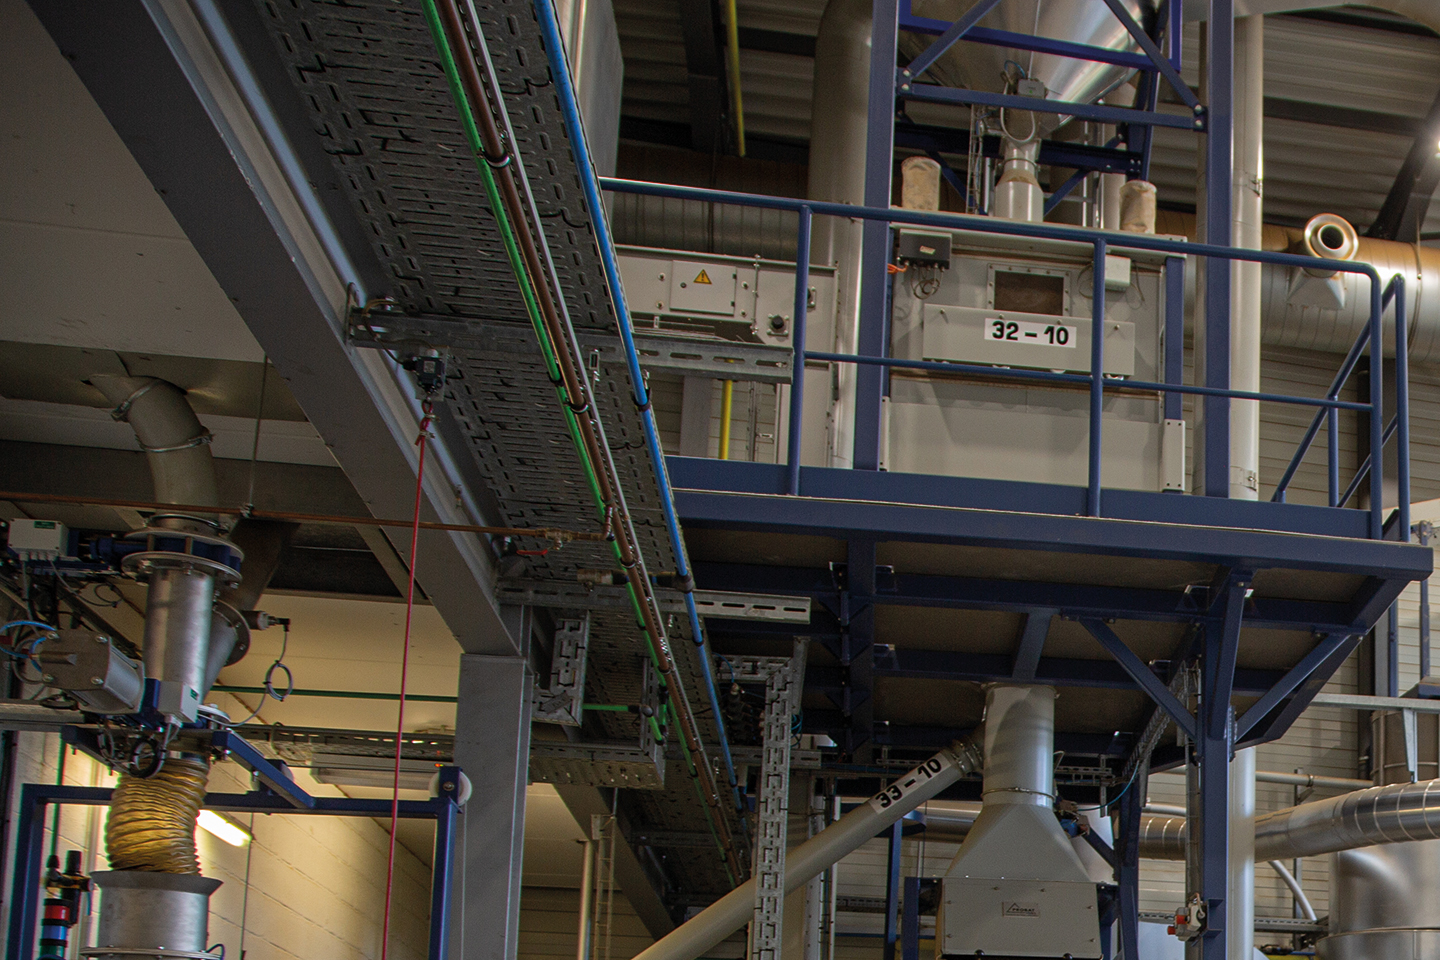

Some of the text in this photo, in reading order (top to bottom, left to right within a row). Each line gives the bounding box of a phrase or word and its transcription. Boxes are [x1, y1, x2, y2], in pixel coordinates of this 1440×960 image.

[992, 320, 1019, 341] 32
[1044, 325, 1069, 345] 10
[875, 784, 903, 808] 33
[917, 758, 942, 779] 10
